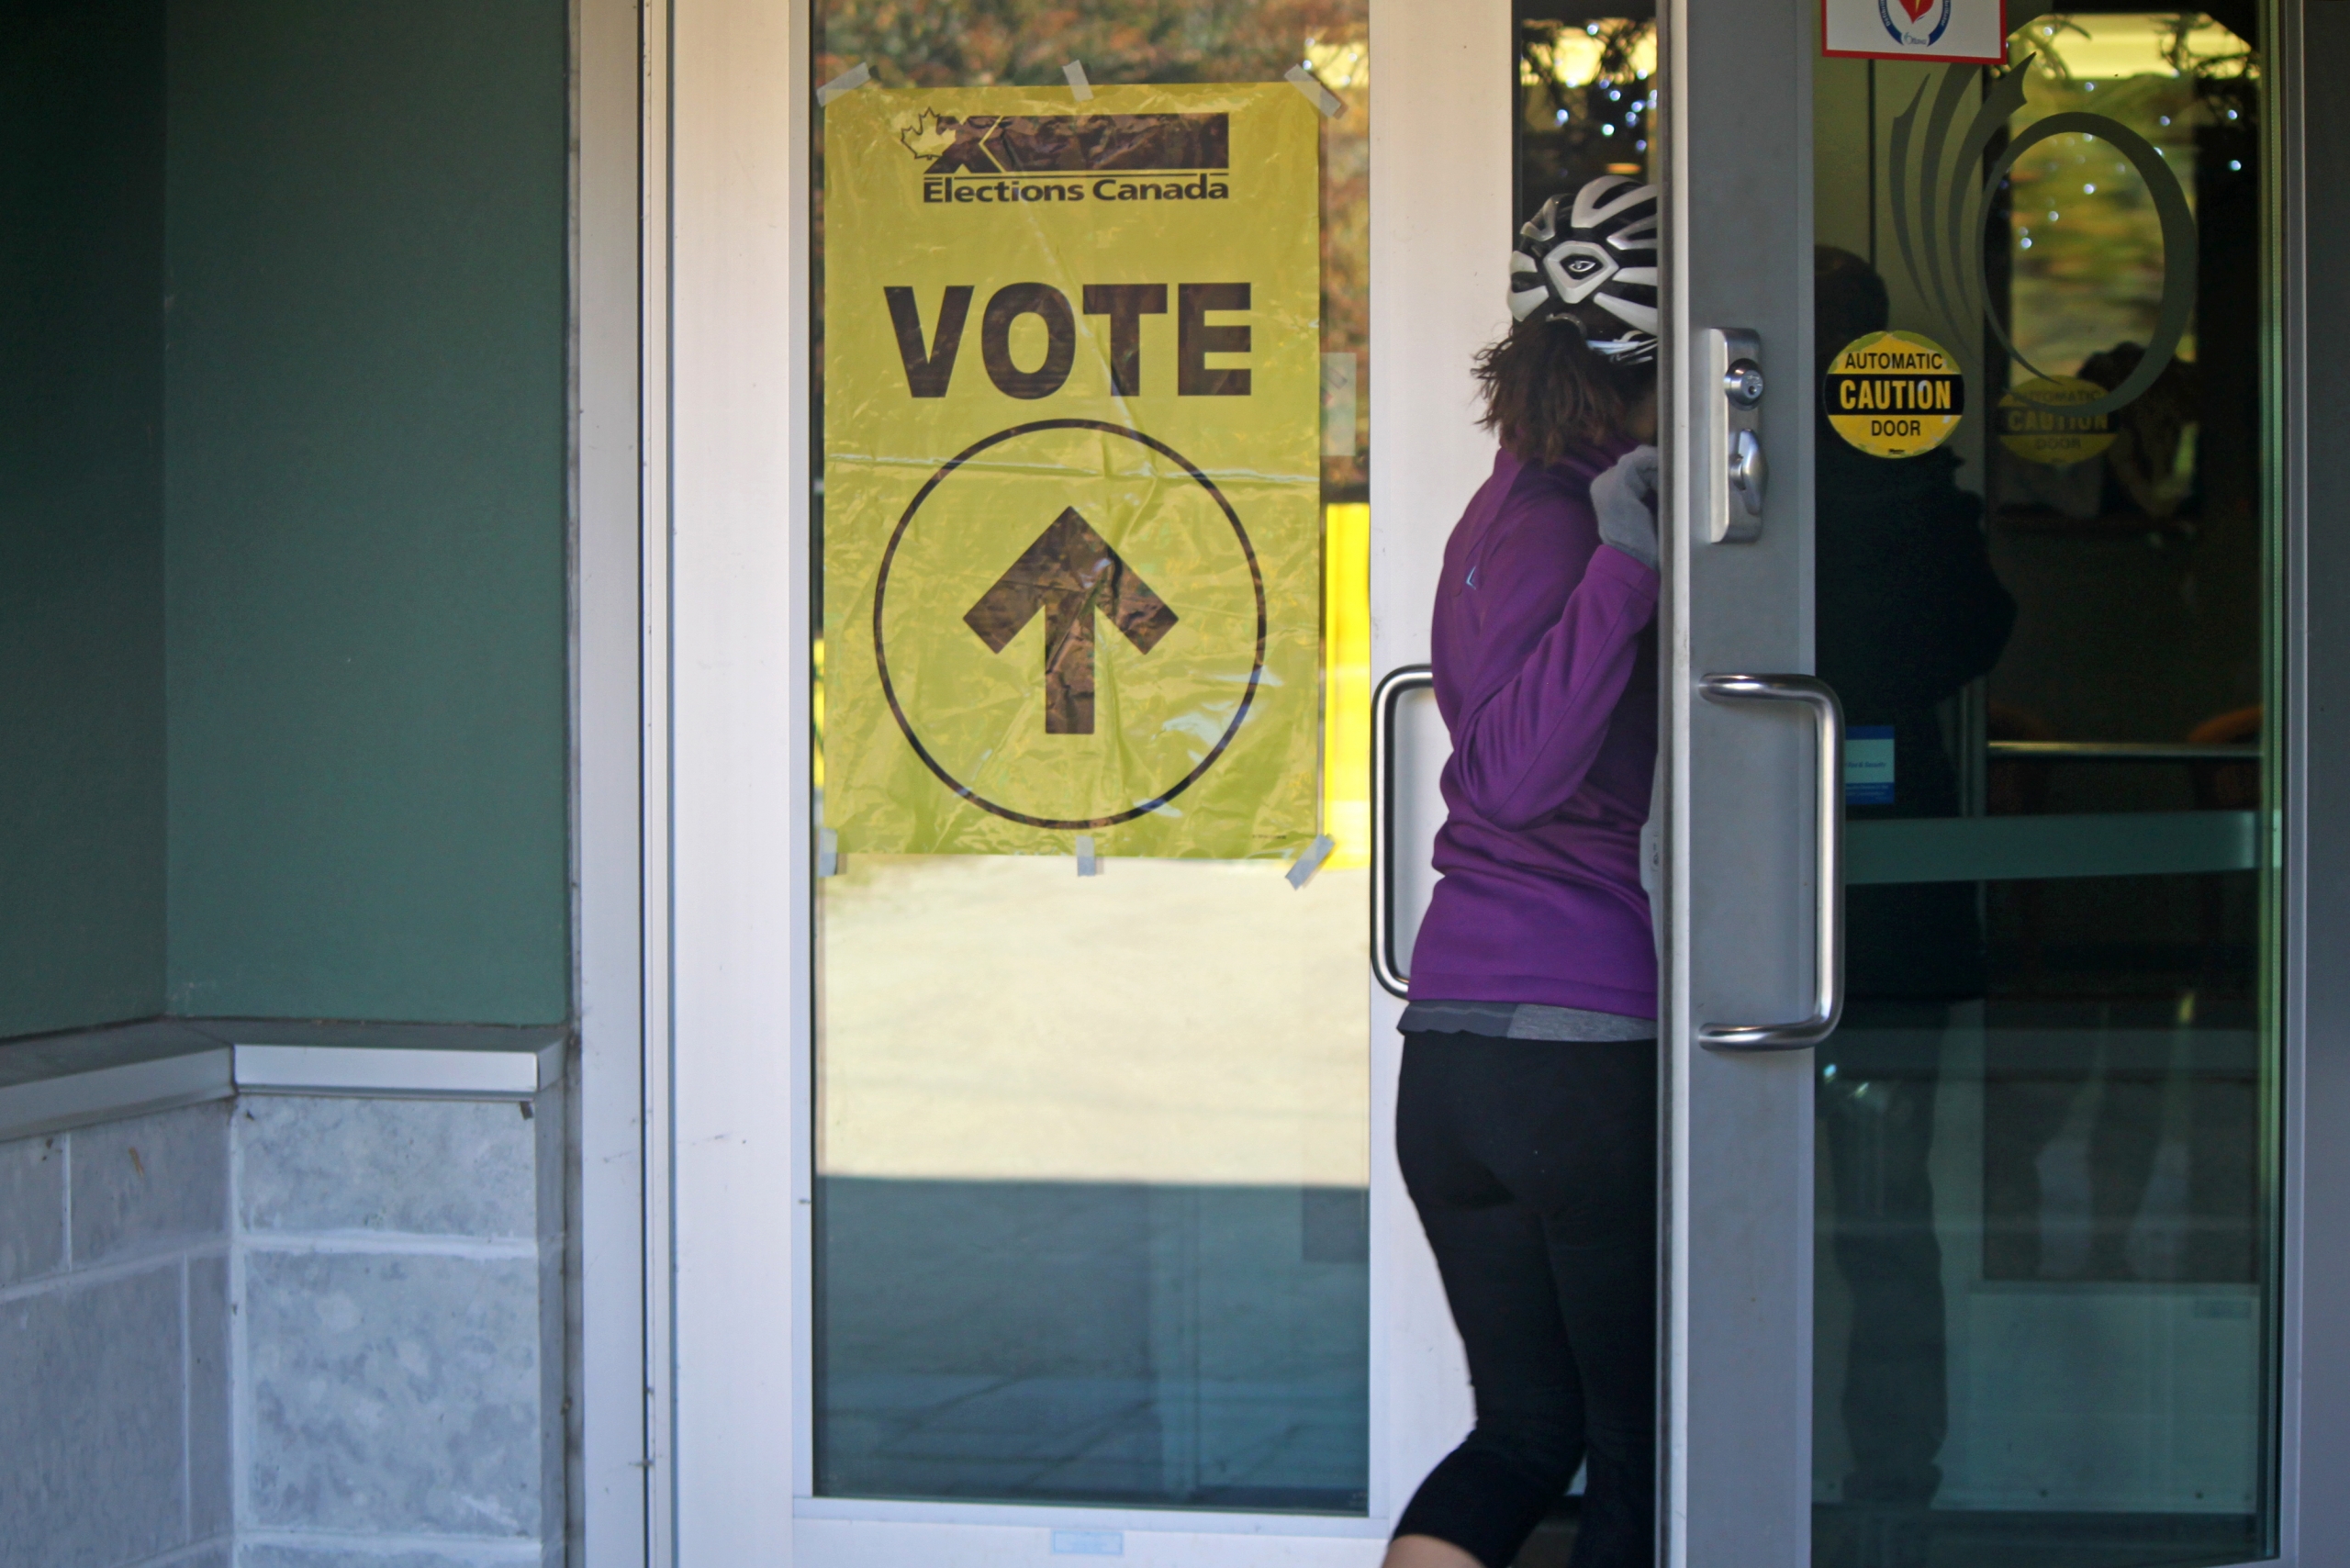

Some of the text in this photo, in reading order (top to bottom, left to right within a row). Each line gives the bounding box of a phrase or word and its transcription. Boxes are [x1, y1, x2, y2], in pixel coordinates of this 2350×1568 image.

[923, 174, 1229, 203] Elections Canada
[883, 281, 1251, 399] VOTE
[1845, 353, 1943, 370] AUTOMATIC
[1840, 379, 1952, 410] CAUTION
[1871, 420, 1921, 437] DOOR
